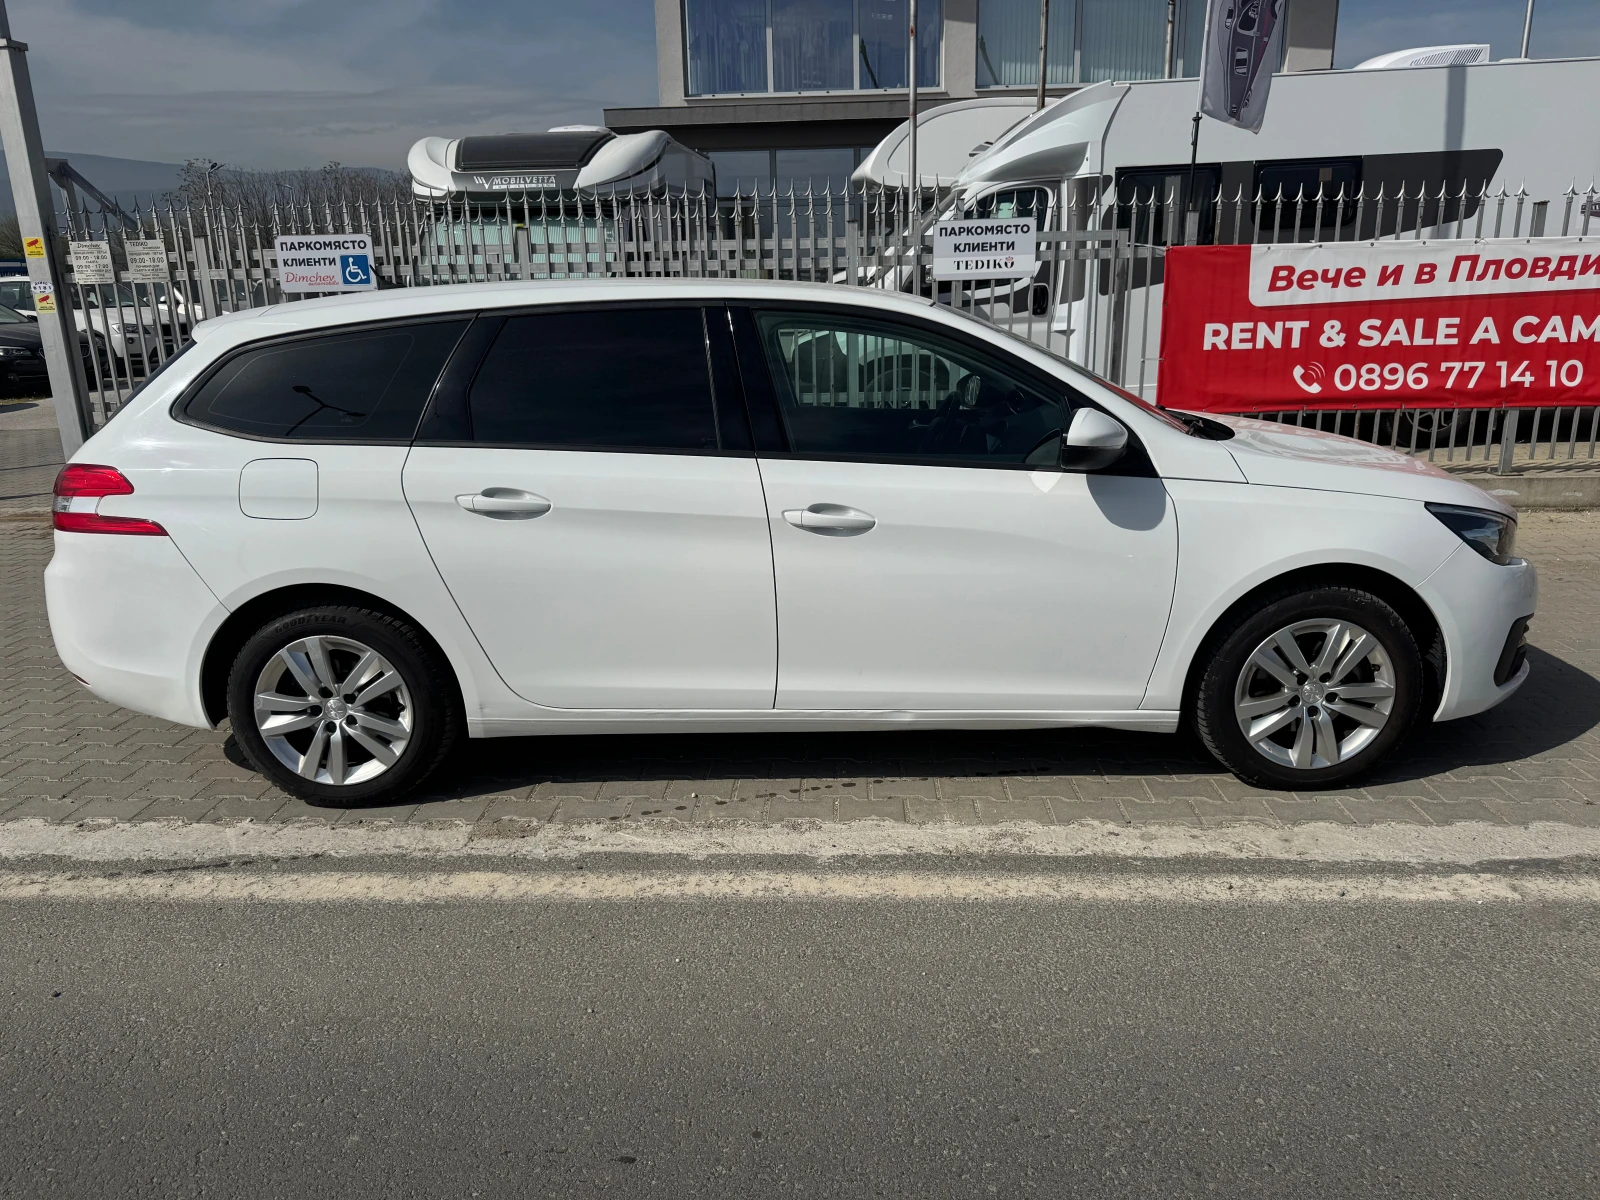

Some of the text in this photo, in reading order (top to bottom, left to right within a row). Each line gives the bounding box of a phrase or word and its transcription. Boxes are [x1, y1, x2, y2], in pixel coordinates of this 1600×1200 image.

[493, 176, 556, 185] MOBILVETTA
[939, 224, 1031, 237] ПАРКОМЯСТО
[280, 239, 367, 252] ПАРКОМЯСТО
[953, 241, 1015, 253] КЛИЕНТИ
[283, 257, 337, 267] КЛИЕНТИ
[953, 257, 1015, 270] TEDIKO
[285, 272, 335, 283] Dimchev
[1267, 265, 1367, 292] Вече
[1377, 264, 1405, 286] и
[1414, 263, 1438, 284] в
[1203, 314, 1600, 350] RENT & SALE A CAM
[1334, 359, 1584, 391] 0896 77 14 10
[275, 614, 348, 634] GOODYEAR
